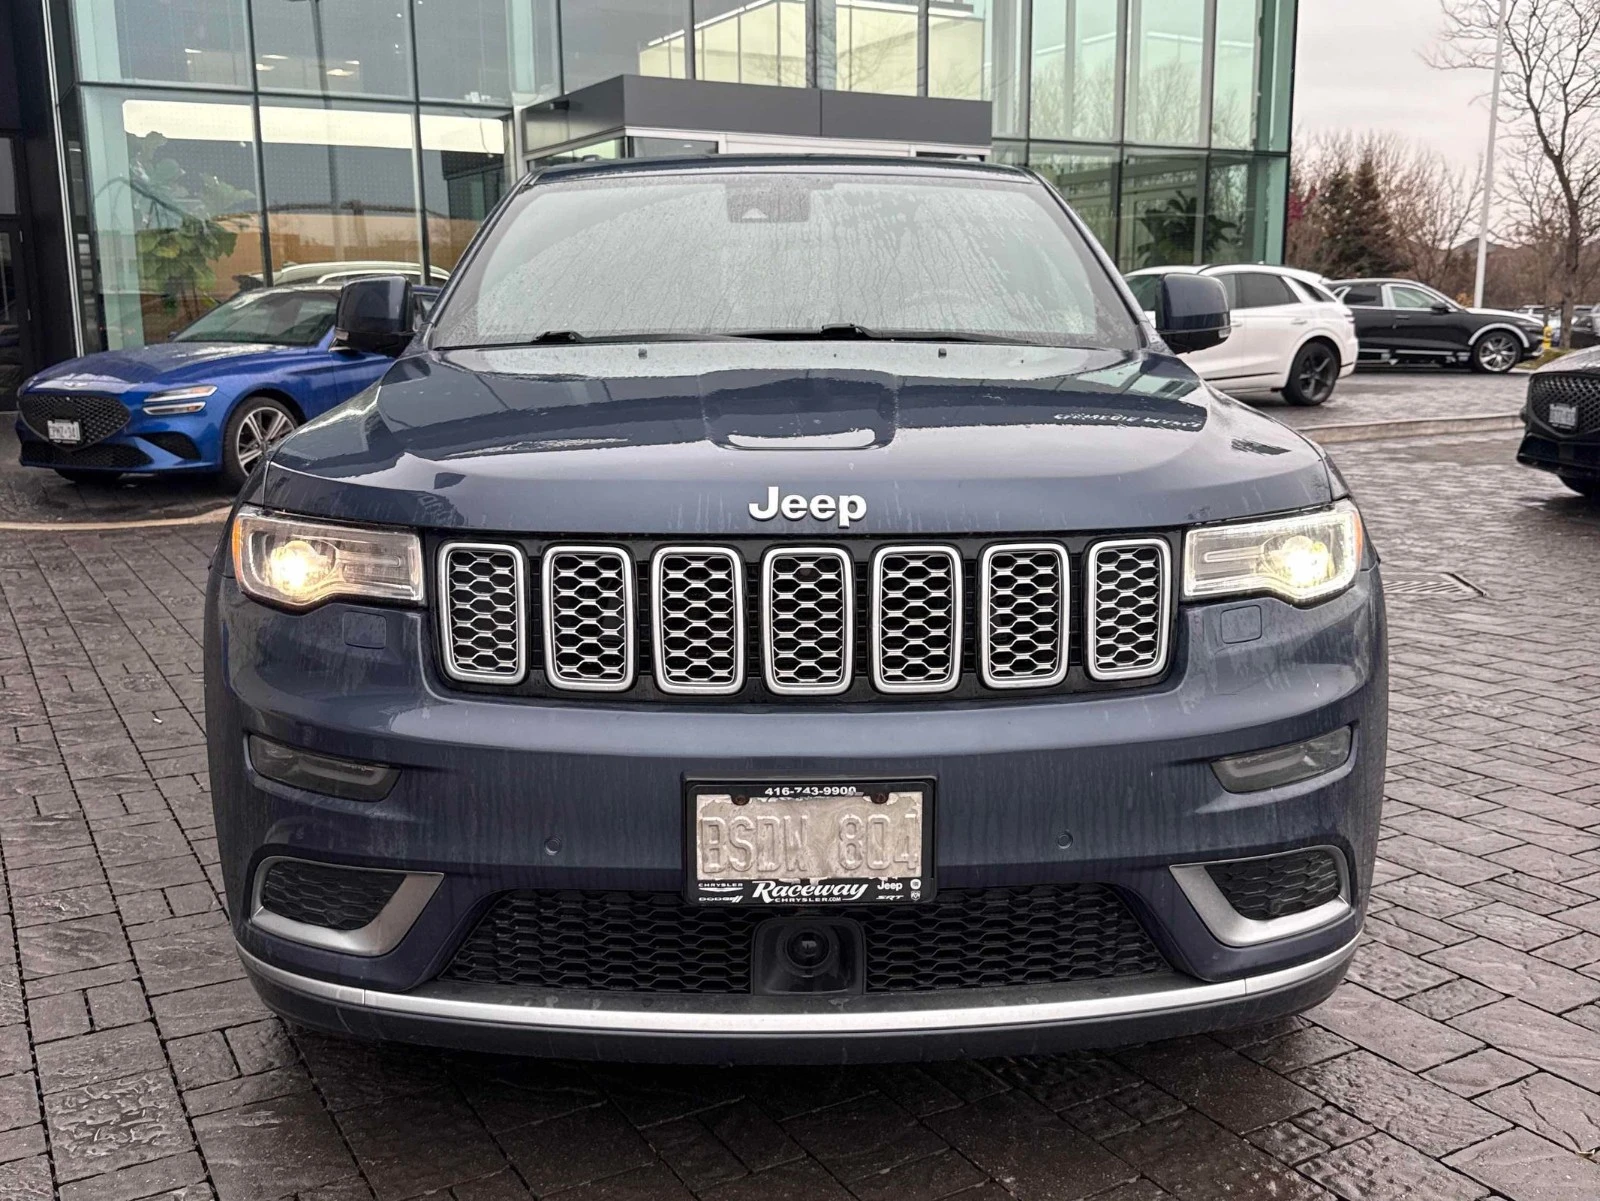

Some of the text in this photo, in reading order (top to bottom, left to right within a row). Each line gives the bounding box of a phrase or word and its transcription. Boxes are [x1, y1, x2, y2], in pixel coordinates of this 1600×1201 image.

[748, 486, 867, 529] Jeep
[765, 786, 857, 796] 416-743-9900
[839, 813, 919, 870] 804
[752, 880, 869, 904] Raceway
[877, 880, 903, 891] Jeep
